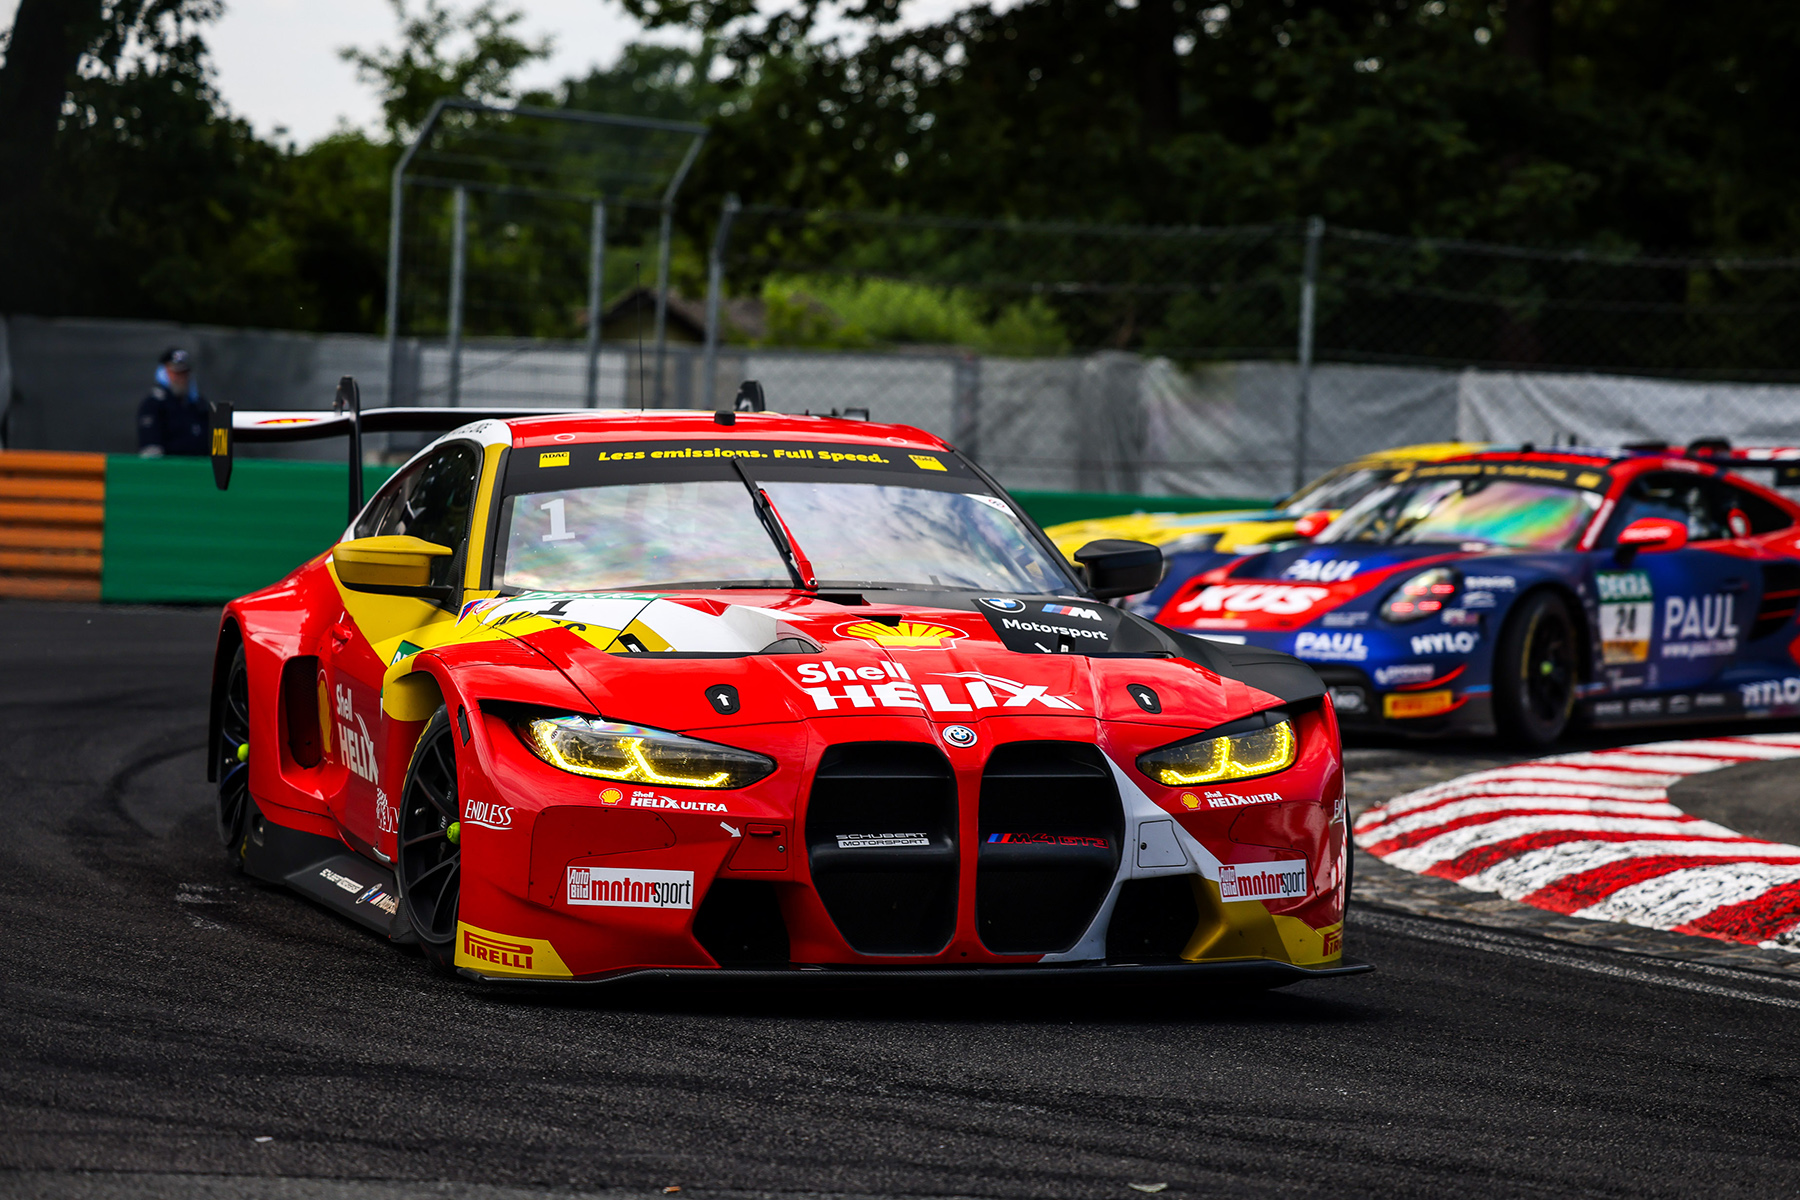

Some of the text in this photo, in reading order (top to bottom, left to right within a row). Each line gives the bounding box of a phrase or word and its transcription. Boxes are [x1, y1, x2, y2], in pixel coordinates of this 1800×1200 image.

[212, 428, 228, 456] DTM
[598, 447, 890, 464] Less emissions. Full Speed.
[540, 498, 576, 542] 1
[536, 599, 574, 617] 1
[1662, 593, 1739, 640] PAUL
[1002, 617, 1109, 641] Motorsport
[1295, 632, 1369, 652] PAUL
[797, 661, 911, 683] Shell
[335, 683, 353, 722] Shell
[809, 677, 1085, 712] HELIX
[337, 721, 379, 786] HELIX
[632, 790, 654, 798] Shell
[1204, 791, 1222, 799] Shell
[1207, 792, 1282, 808] HELIX ULTRA
[630, 795, 728, 812] HELIX ULTRA
[464, 799, 515, 827] ENDLESS
[836, 832, 927, 840] SCHUBERT
[842, 838, 925, 847] MOTORSPORT
[1007, 832, 1109, 849] M4 GT3
[570, 869, 589, 885] Auto
[1220, 867, 1235, 882] Auto
[570, 885, 589, 899] Bild
[1222, 882, 1237, 896] Bild
[464, 930, 534, 969] PIRELLI
